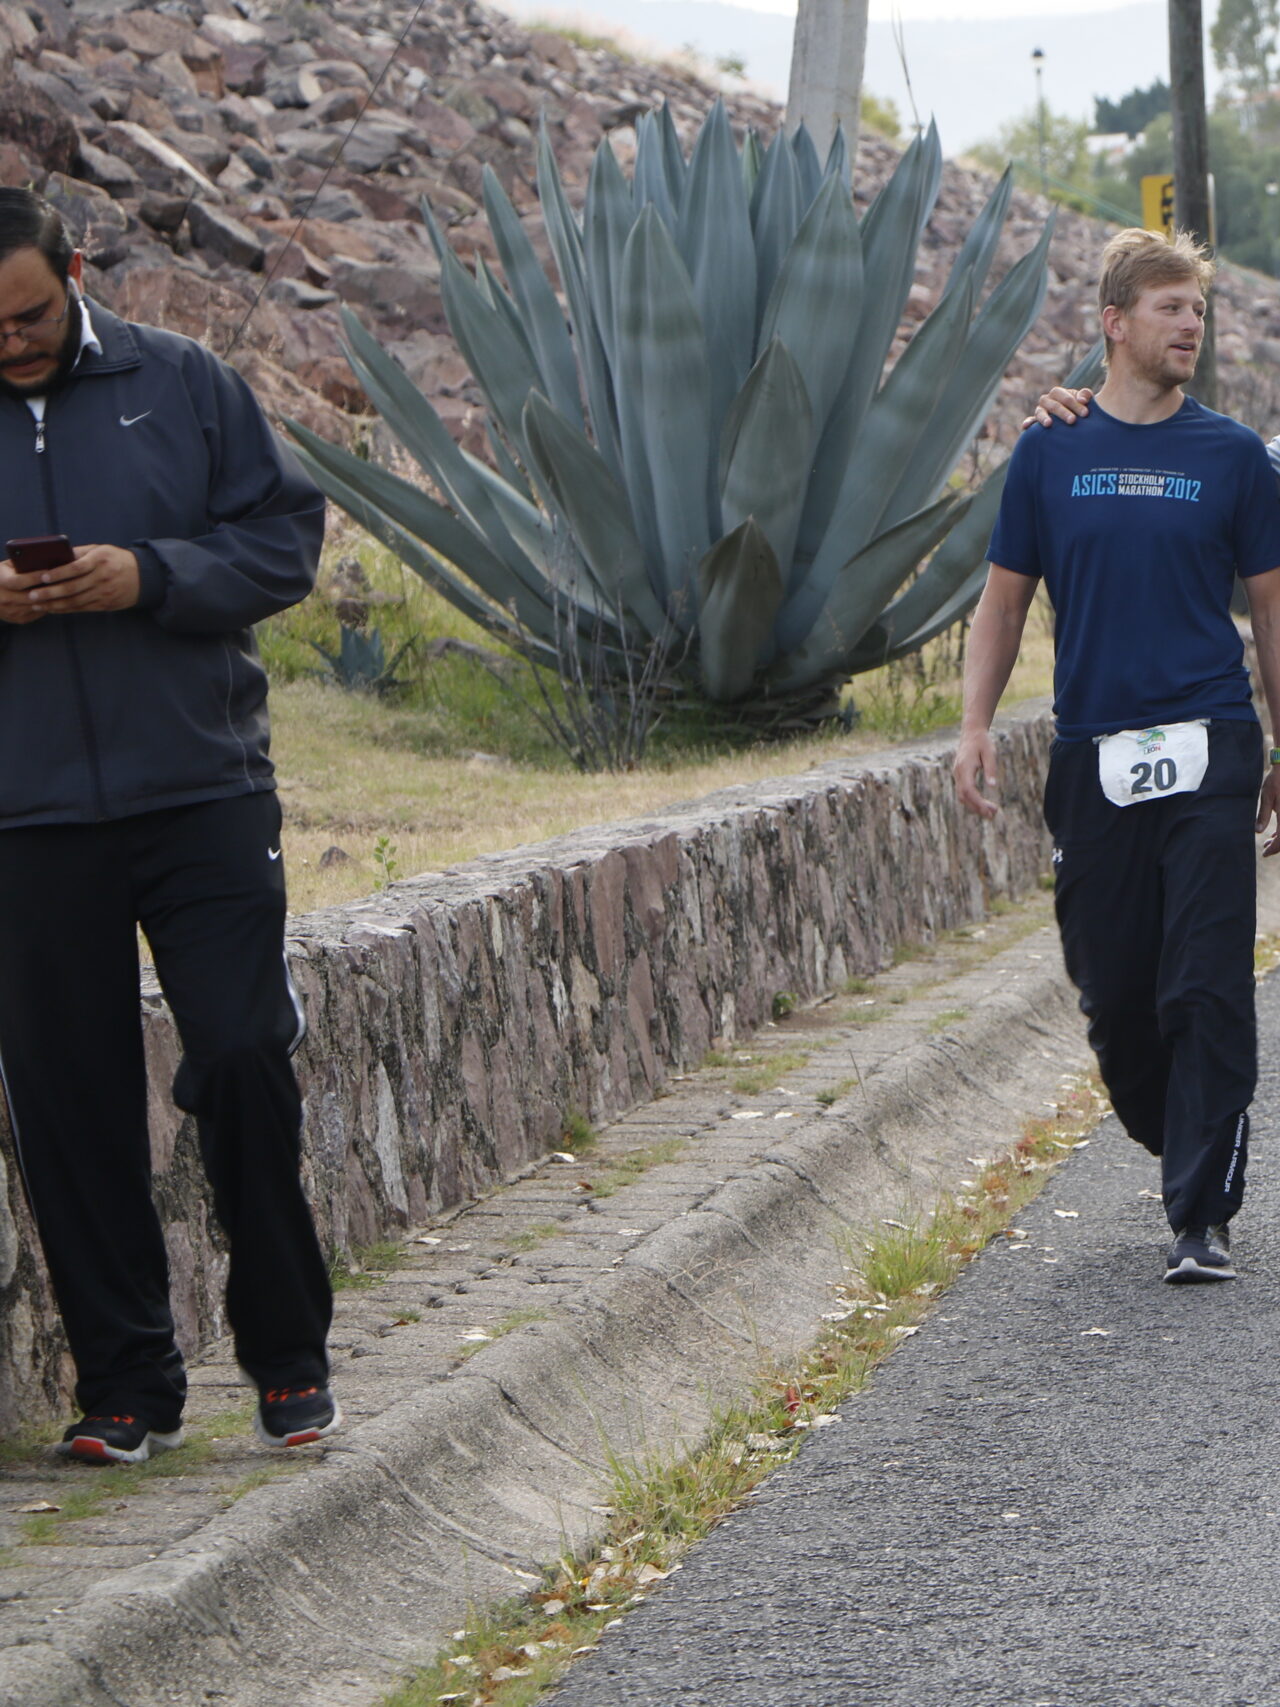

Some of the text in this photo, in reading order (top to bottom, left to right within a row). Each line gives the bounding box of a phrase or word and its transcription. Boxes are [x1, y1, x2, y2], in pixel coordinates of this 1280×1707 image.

[1071, 473, 1165, 498] ASICS STOCKHOLM
[1117, 476, 1202, 502] MARATHON 2012
[1130, 758, 1177, 795] 20
[1234, 1112, 1246, 1148] UNDER
[1224, 1148, 1239, 1193] ARMOUR
